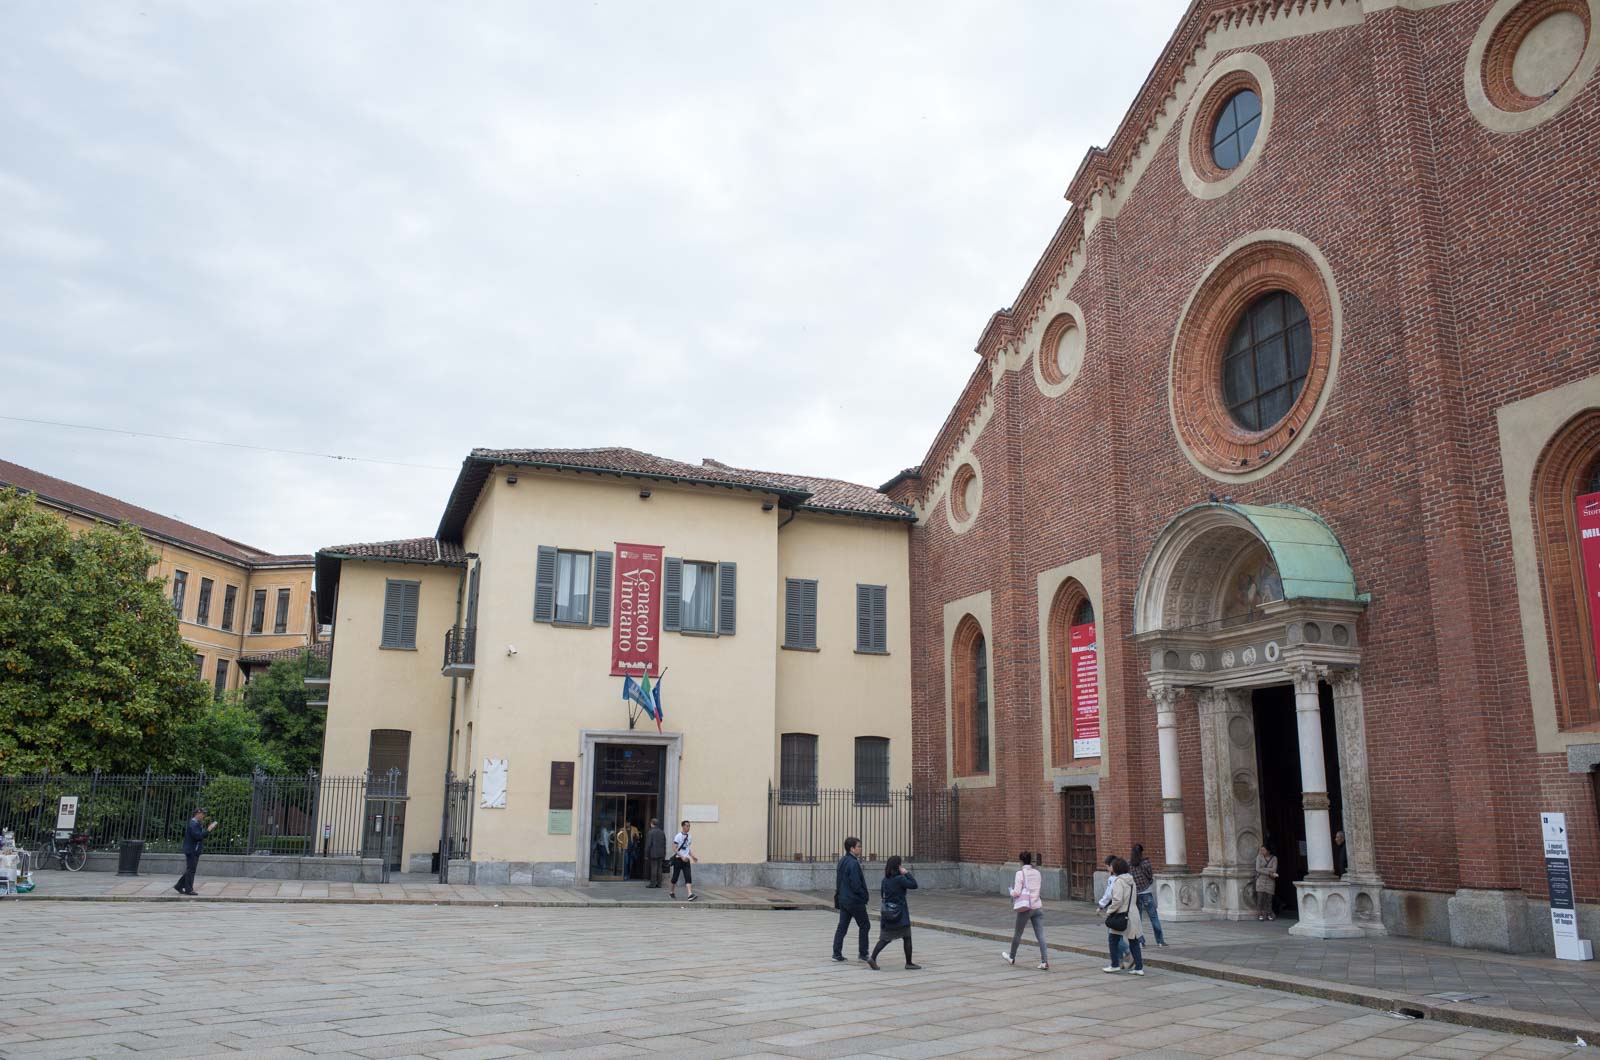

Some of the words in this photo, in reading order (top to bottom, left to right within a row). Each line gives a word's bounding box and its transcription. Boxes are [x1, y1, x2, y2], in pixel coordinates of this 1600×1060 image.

[619, 568, 639, 652] Vinciano
[635, 568, 656, 653] Cenacolo
[1553, 911, 1573, 919] Seekers
[1561, 918, 1573, 926] hope
